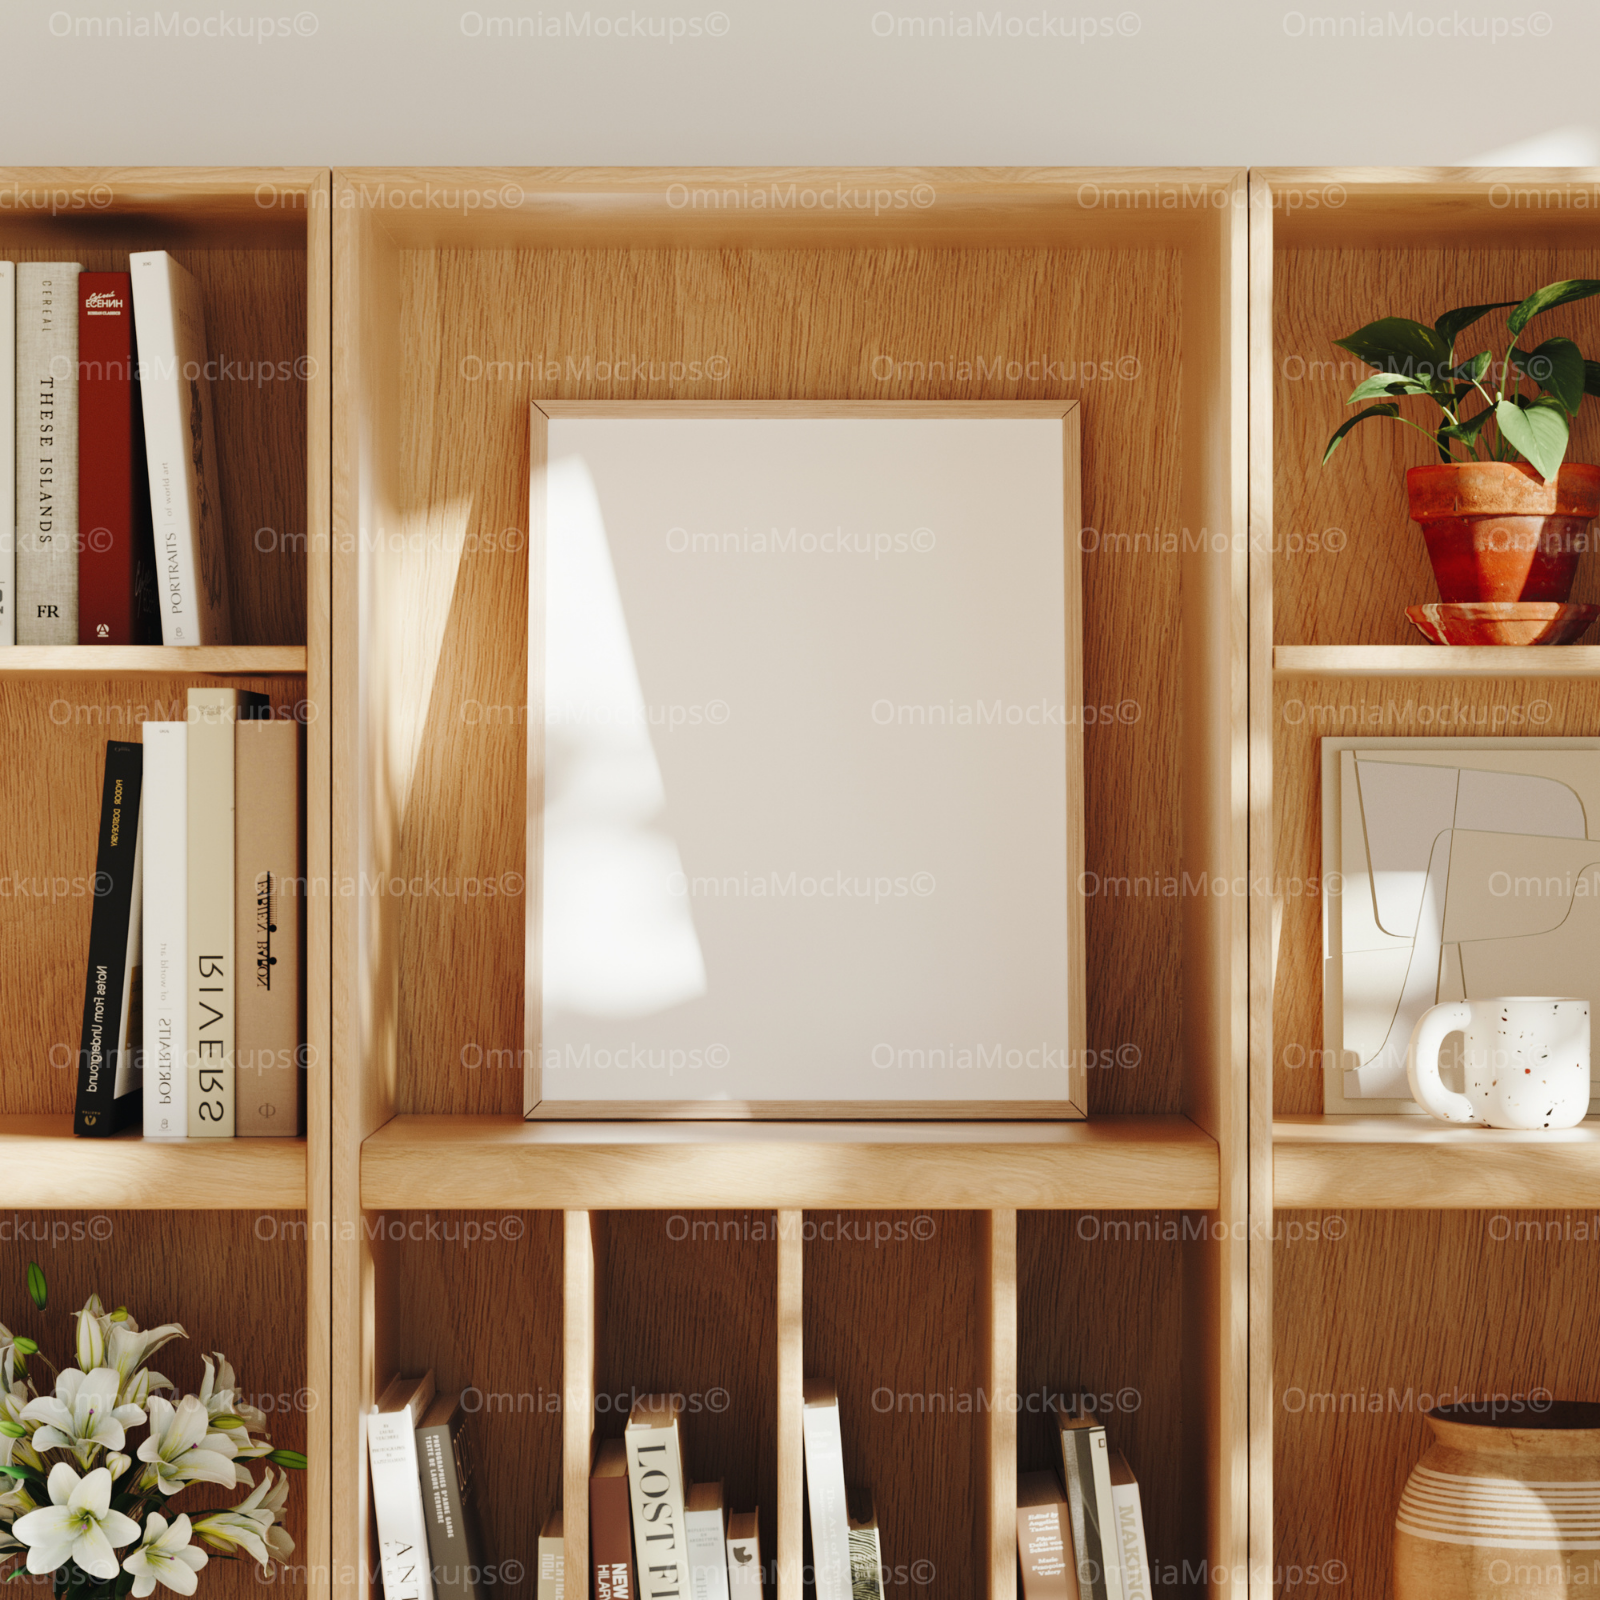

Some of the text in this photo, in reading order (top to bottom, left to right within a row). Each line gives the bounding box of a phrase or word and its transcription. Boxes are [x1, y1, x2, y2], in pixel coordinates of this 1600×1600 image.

[42, 280, 52, 332] CEREAL
[86, 299, 122, 308] ЕСЕНИН
[39, 377, 54, 543] THESE ISLANDS
[162, 478, 172, 506] world
[165, 532, 183, 614] PORTRAITS
[37, 604, 60, 618] FR
[425, 1436, 434, 1456] TEXTE
[428, 1458, 436, 1467] DE
[430, 1469, 440, 1490] LAURE
[432, 1434, 448, 1488] PHOTOGRAPHIES
[446, 1516, 454, 1538] GARDE
[636, 1442, 676, 1550] LOST
[826, 1486, 836, 1513] The
[828, 1516, 838, 1539] Art
[830, 1542, 840, 1556] of
[612, 1562, 629, 1600] NEW
